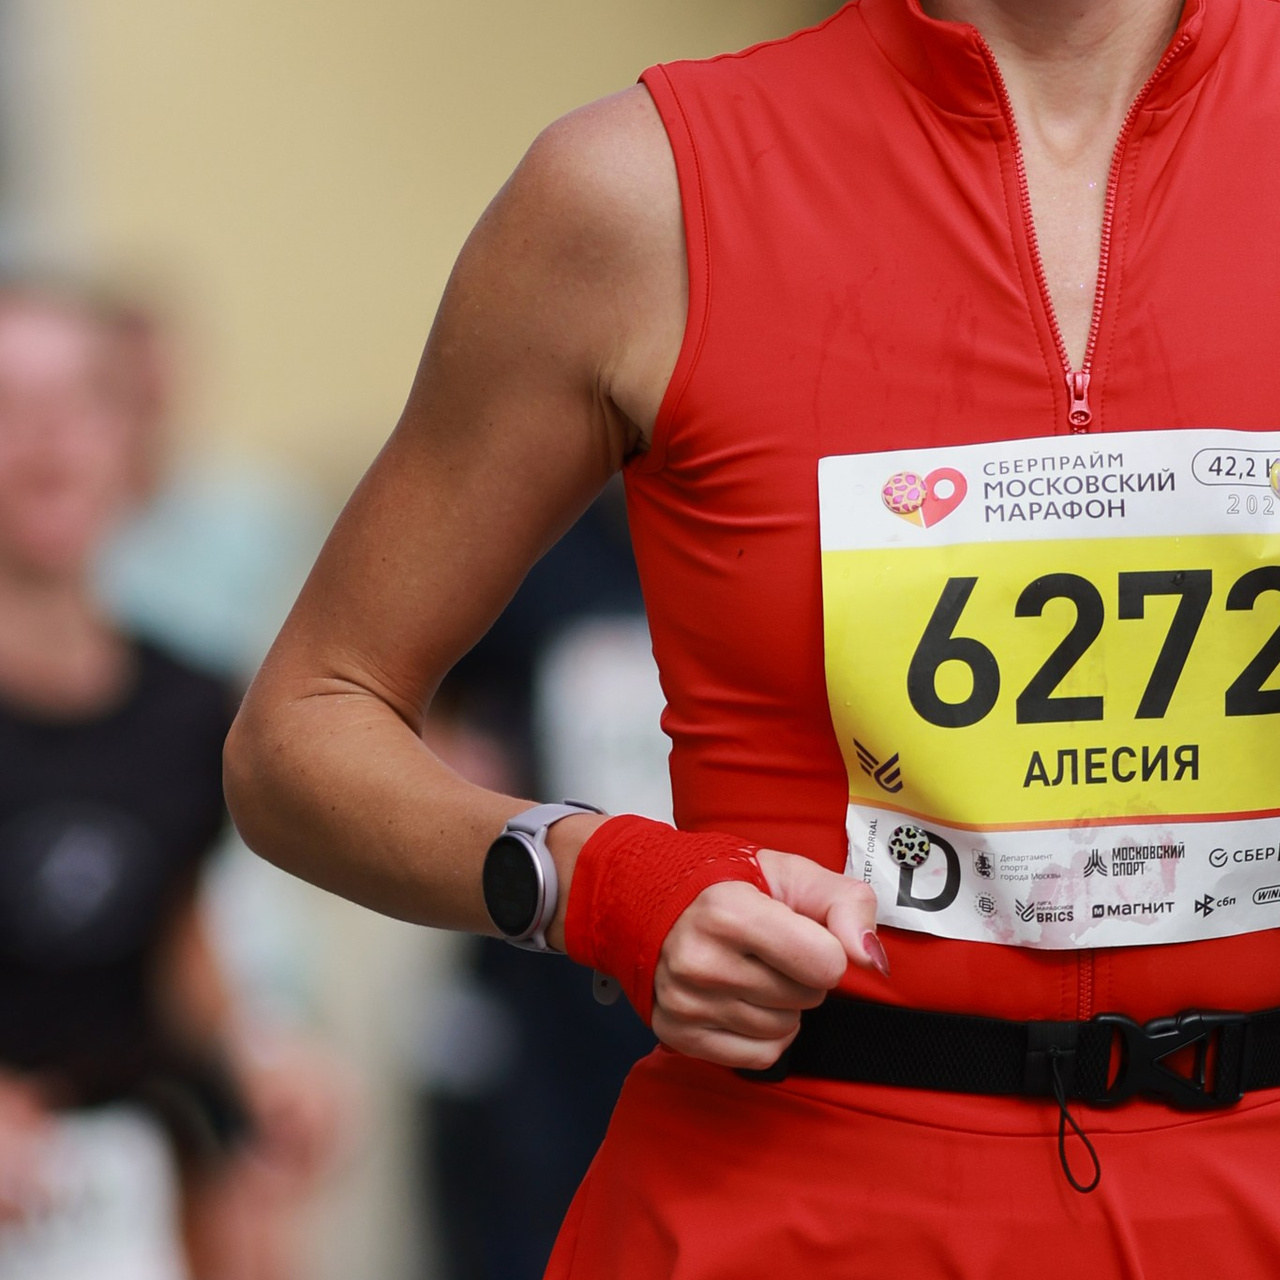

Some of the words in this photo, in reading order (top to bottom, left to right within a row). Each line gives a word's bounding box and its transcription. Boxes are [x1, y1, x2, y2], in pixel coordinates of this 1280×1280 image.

[983, 451, 1124, 476] СБЕРПРАЙМ
[1208, 456, 1256, 480] 42,2
[984, 468, 1176, 499] МОСКОВСКИЙ
[985, 498, 1126, 523] МАРАФОН
[1022, 743, 1201, 788] АЛЕСИЯ
[867, 819, 878, 853] CORRAL
[1000, 854, 1053, 863] Департамент
[1112, 841, 1185, 861] МОСКОВСКИЙ
[1233, 847, 1276, 863] СБЕР
[863, 860, 873, 884] СТЕР
[895, 830, 962, 913] D
[1000, 864, 1029, 873] спорта
[1000, 873, 1029, 882] города
[1031, 872, 1061, 880] Москвы
[1112, 861, 1146, 877] СПОРТ
[1036, 911, 1074, 923] BRICS
